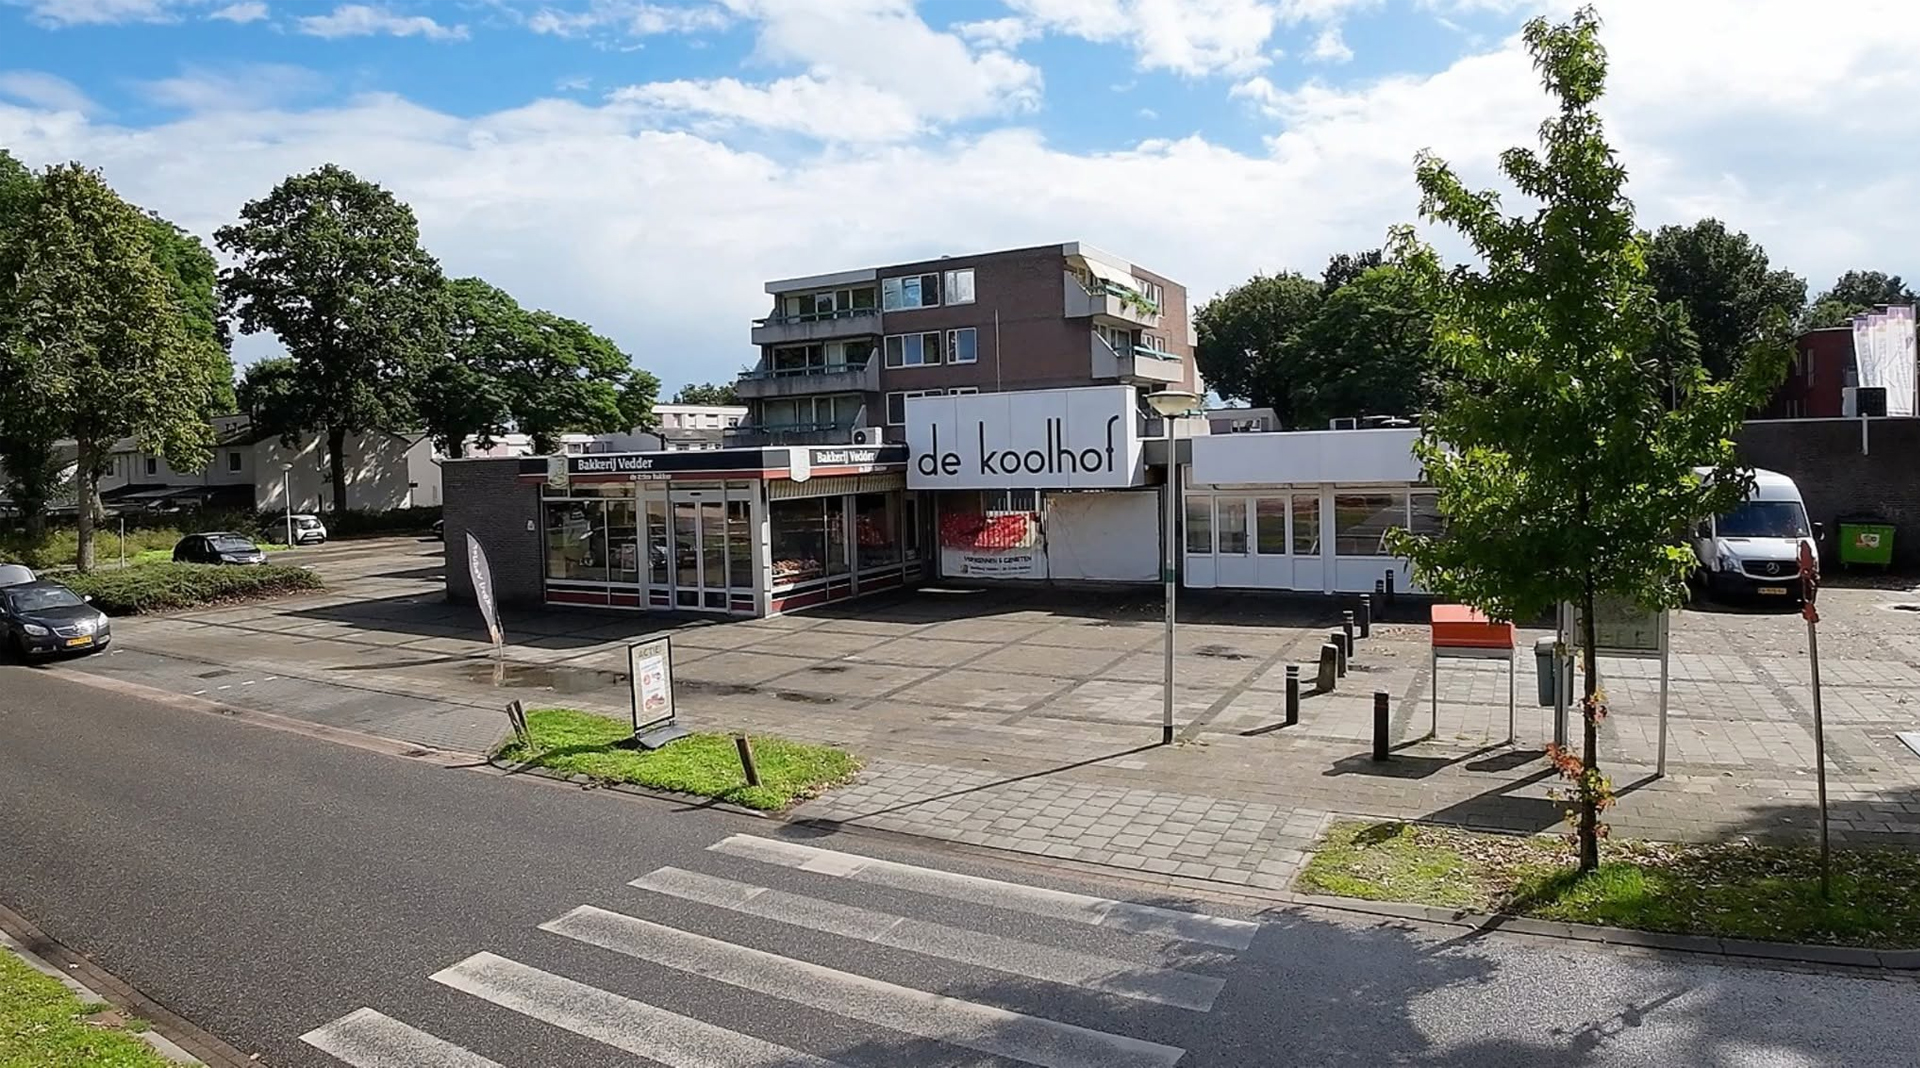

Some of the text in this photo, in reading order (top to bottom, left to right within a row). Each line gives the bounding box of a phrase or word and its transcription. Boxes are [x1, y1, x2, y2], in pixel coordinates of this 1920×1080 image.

[918, 415, 1119, 475] de koolhof
[578, 458, 617, 472] Bakkerij
[618, 457, 653, 469] Vedder
[815, 450, 875, 464] Bakkerij Vedder
